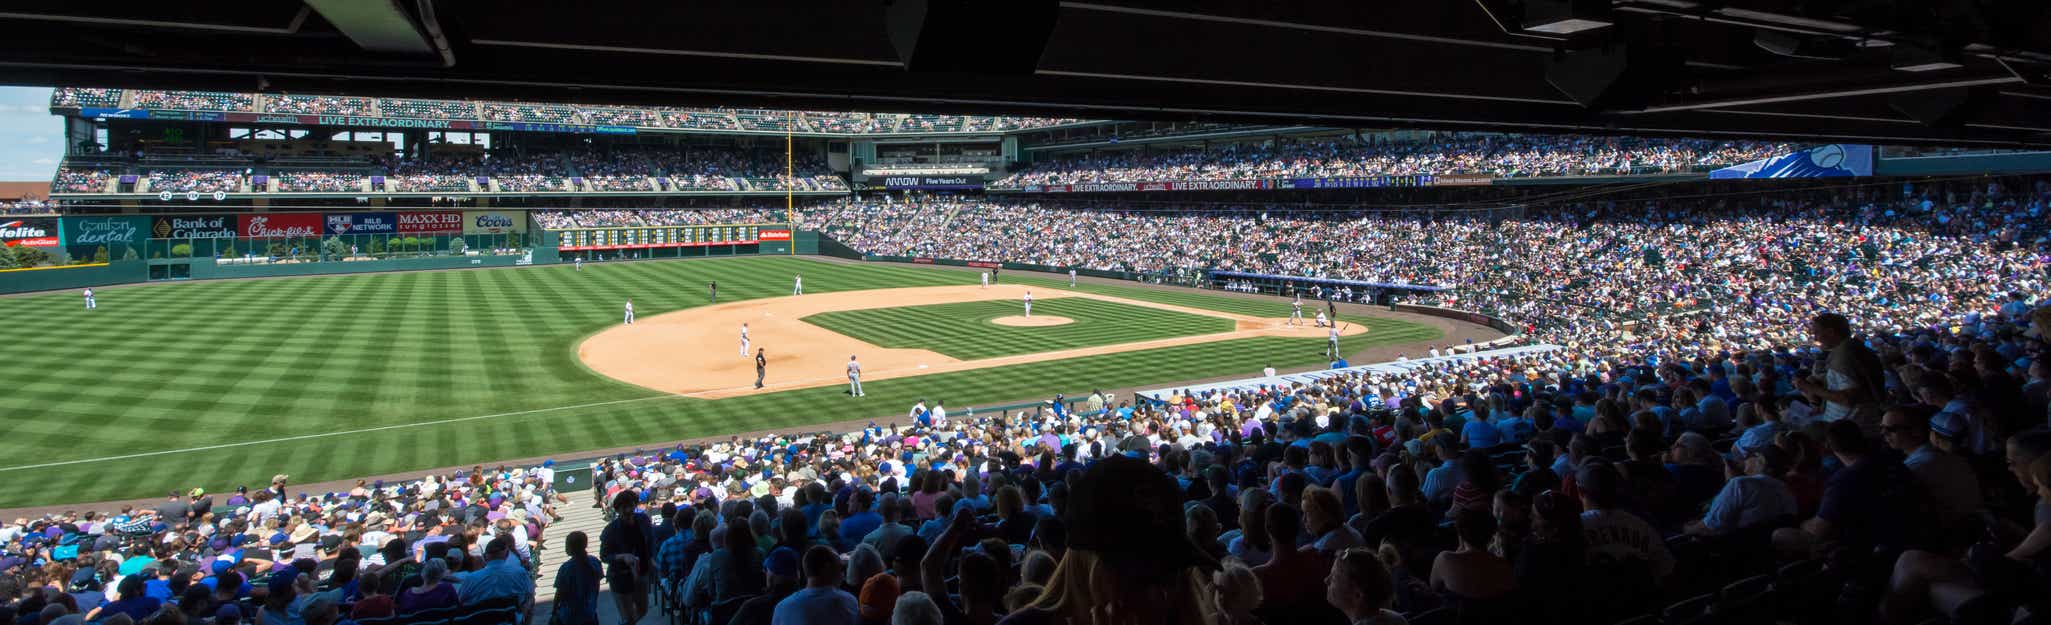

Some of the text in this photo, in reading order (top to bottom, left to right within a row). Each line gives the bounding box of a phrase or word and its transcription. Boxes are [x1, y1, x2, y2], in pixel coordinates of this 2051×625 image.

[319, 115, 451, 129] LIVE EXTRAORDINARY.
[1071, 183, 1084, 192] LIVE
[1085, 183, 1138, 192] EXTRAORDINARY.
[1172, 180, 1258, 190] LIVE EXTRAORDINARY.
[172, 217, 224, 228] Bank of
[399, 214, 460, 223] MAXX HD
[476, 215, 513, 228] Coors
[80, 218, 129, 231] Comfort
[352, 223, 393, 231] NETWORK
[76, 227, 136, 243] dental
[173, 227, 236, 239] Colorado
